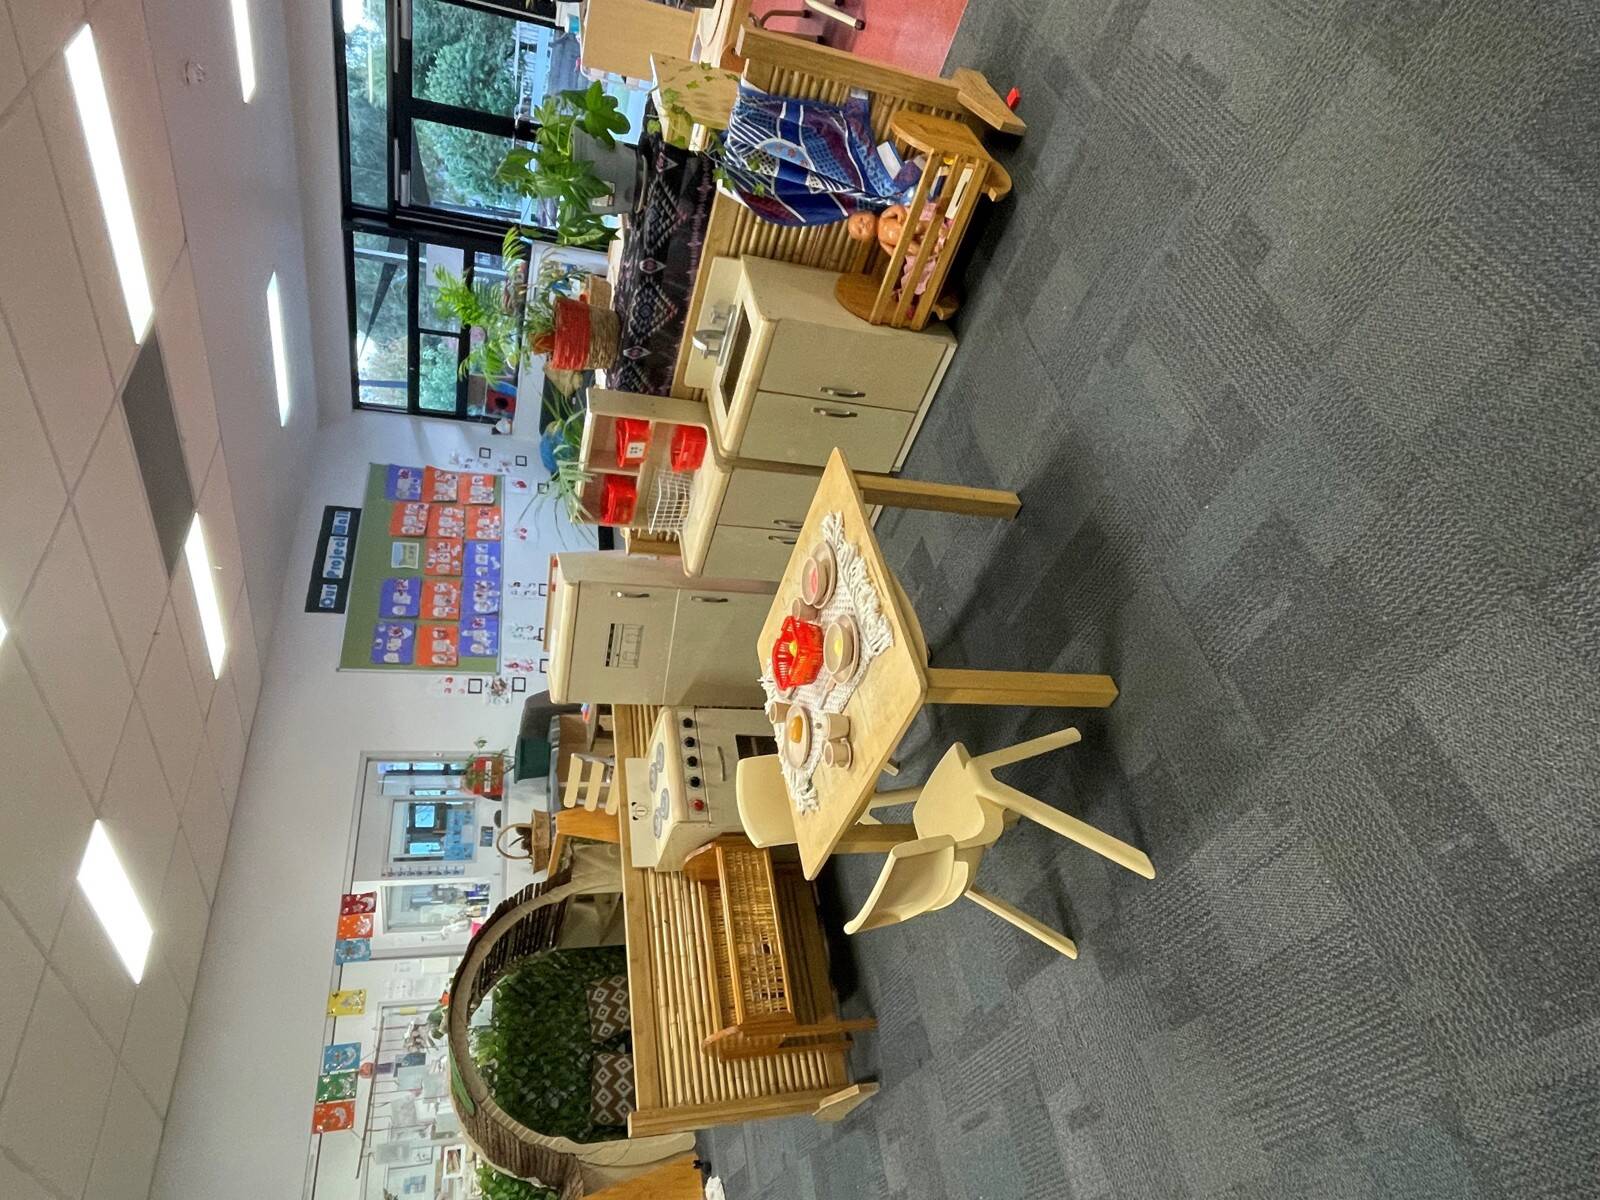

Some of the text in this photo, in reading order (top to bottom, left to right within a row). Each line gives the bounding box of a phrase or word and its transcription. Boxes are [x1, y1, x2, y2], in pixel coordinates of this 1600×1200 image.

[319, 511, 349, 608] Our Project Wall
